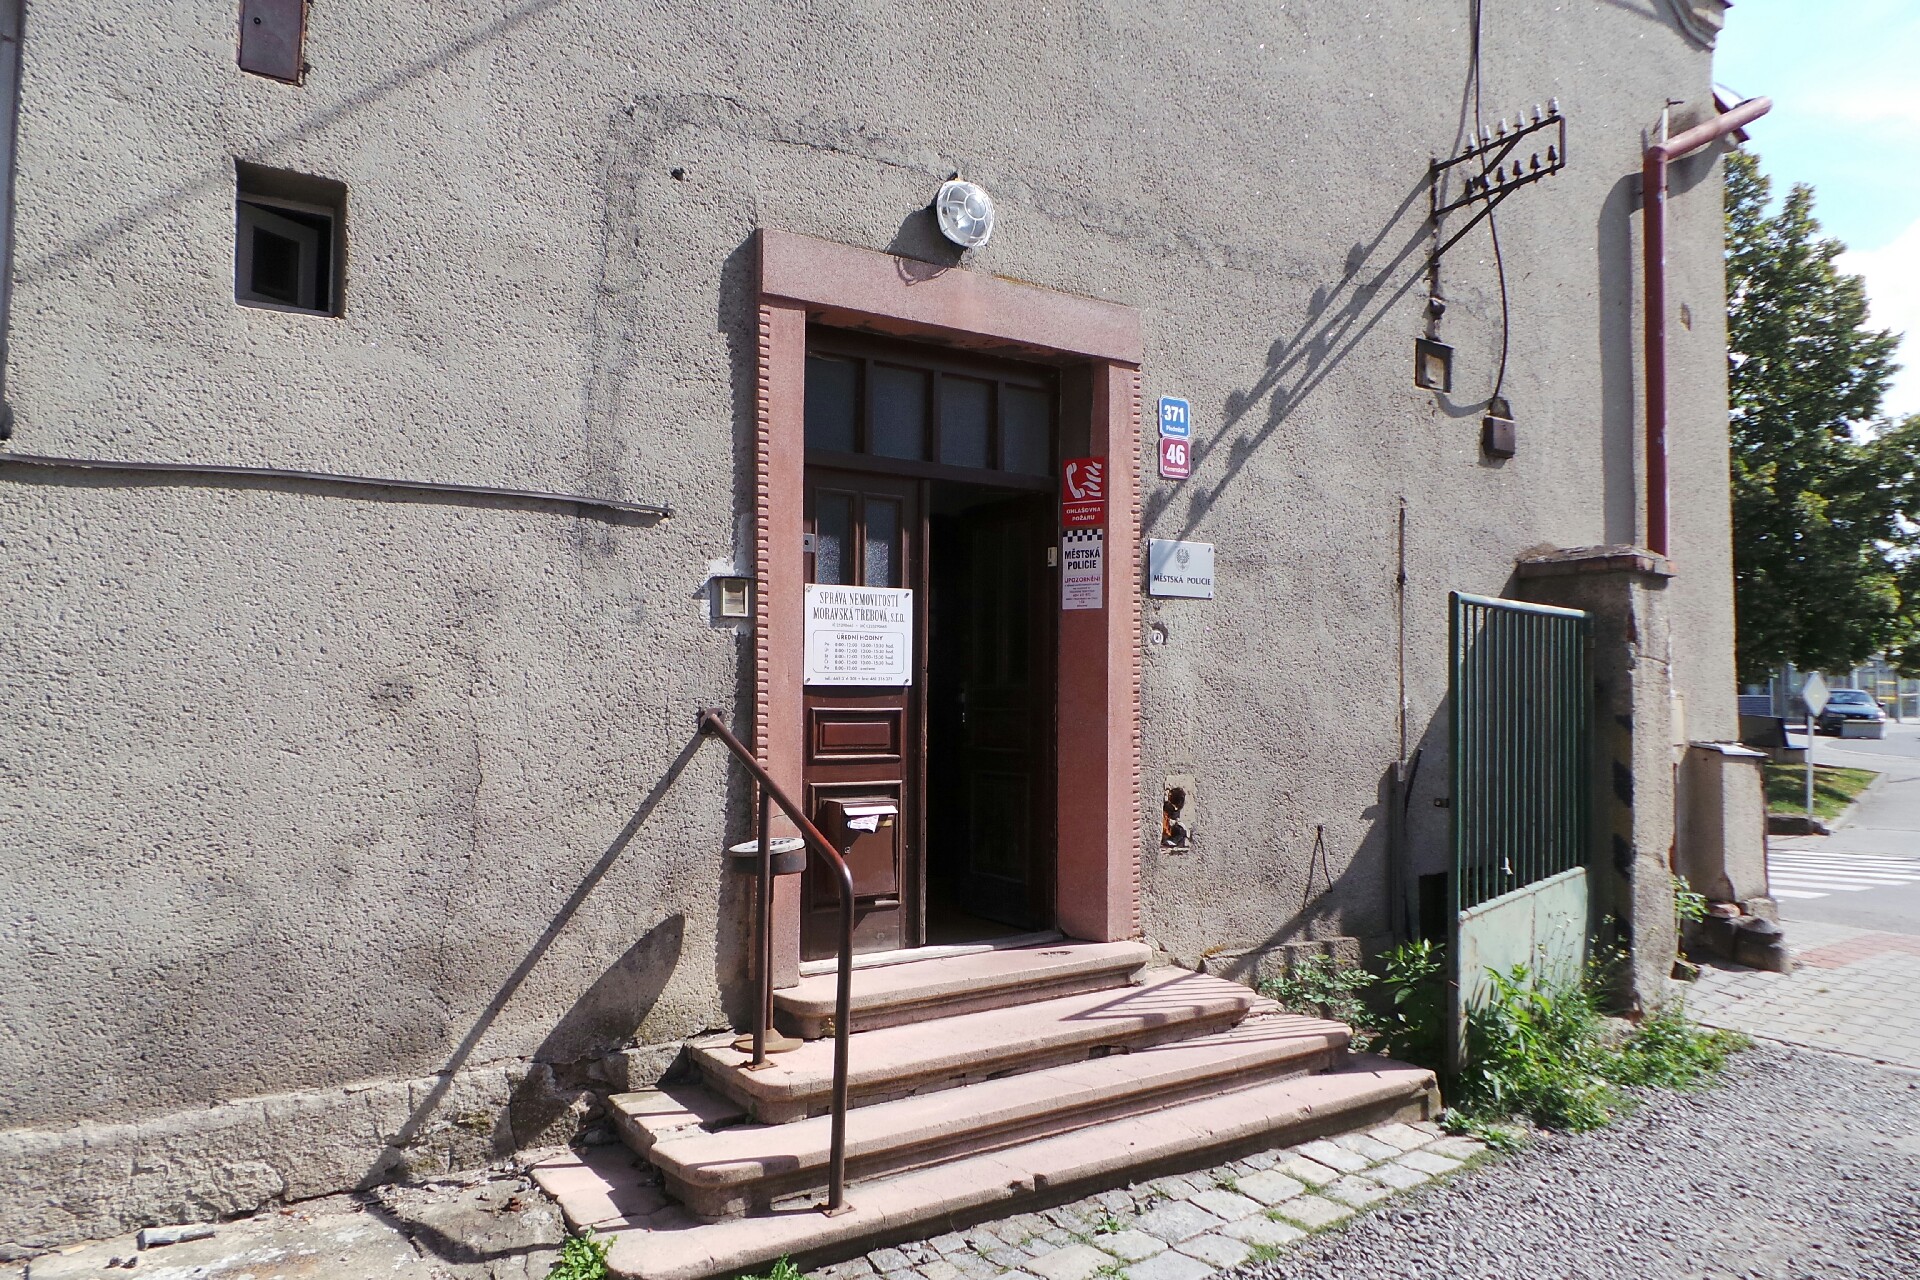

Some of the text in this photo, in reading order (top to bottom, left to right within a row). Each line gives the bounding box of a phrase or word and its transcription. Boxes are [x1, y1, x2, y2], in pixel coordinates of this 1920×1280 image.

[1164, 405, 1185, 423] 371
[1166, 443, 1186, 466] 46
[1065, 547, 1101, 560] MĚSTSKÁ
[1068, 560, 1097, 570] POLICIE
[1153, 573, 1211, 586] MĚSTSKÁ POLICIE
[819, 590, 899, 607] SPRÁVA NEMOVITOSTÍ
[813, 606, 854, 621] MORAVSKÁ
[836, 633, 859, 641] ÚŘEDNÍ
